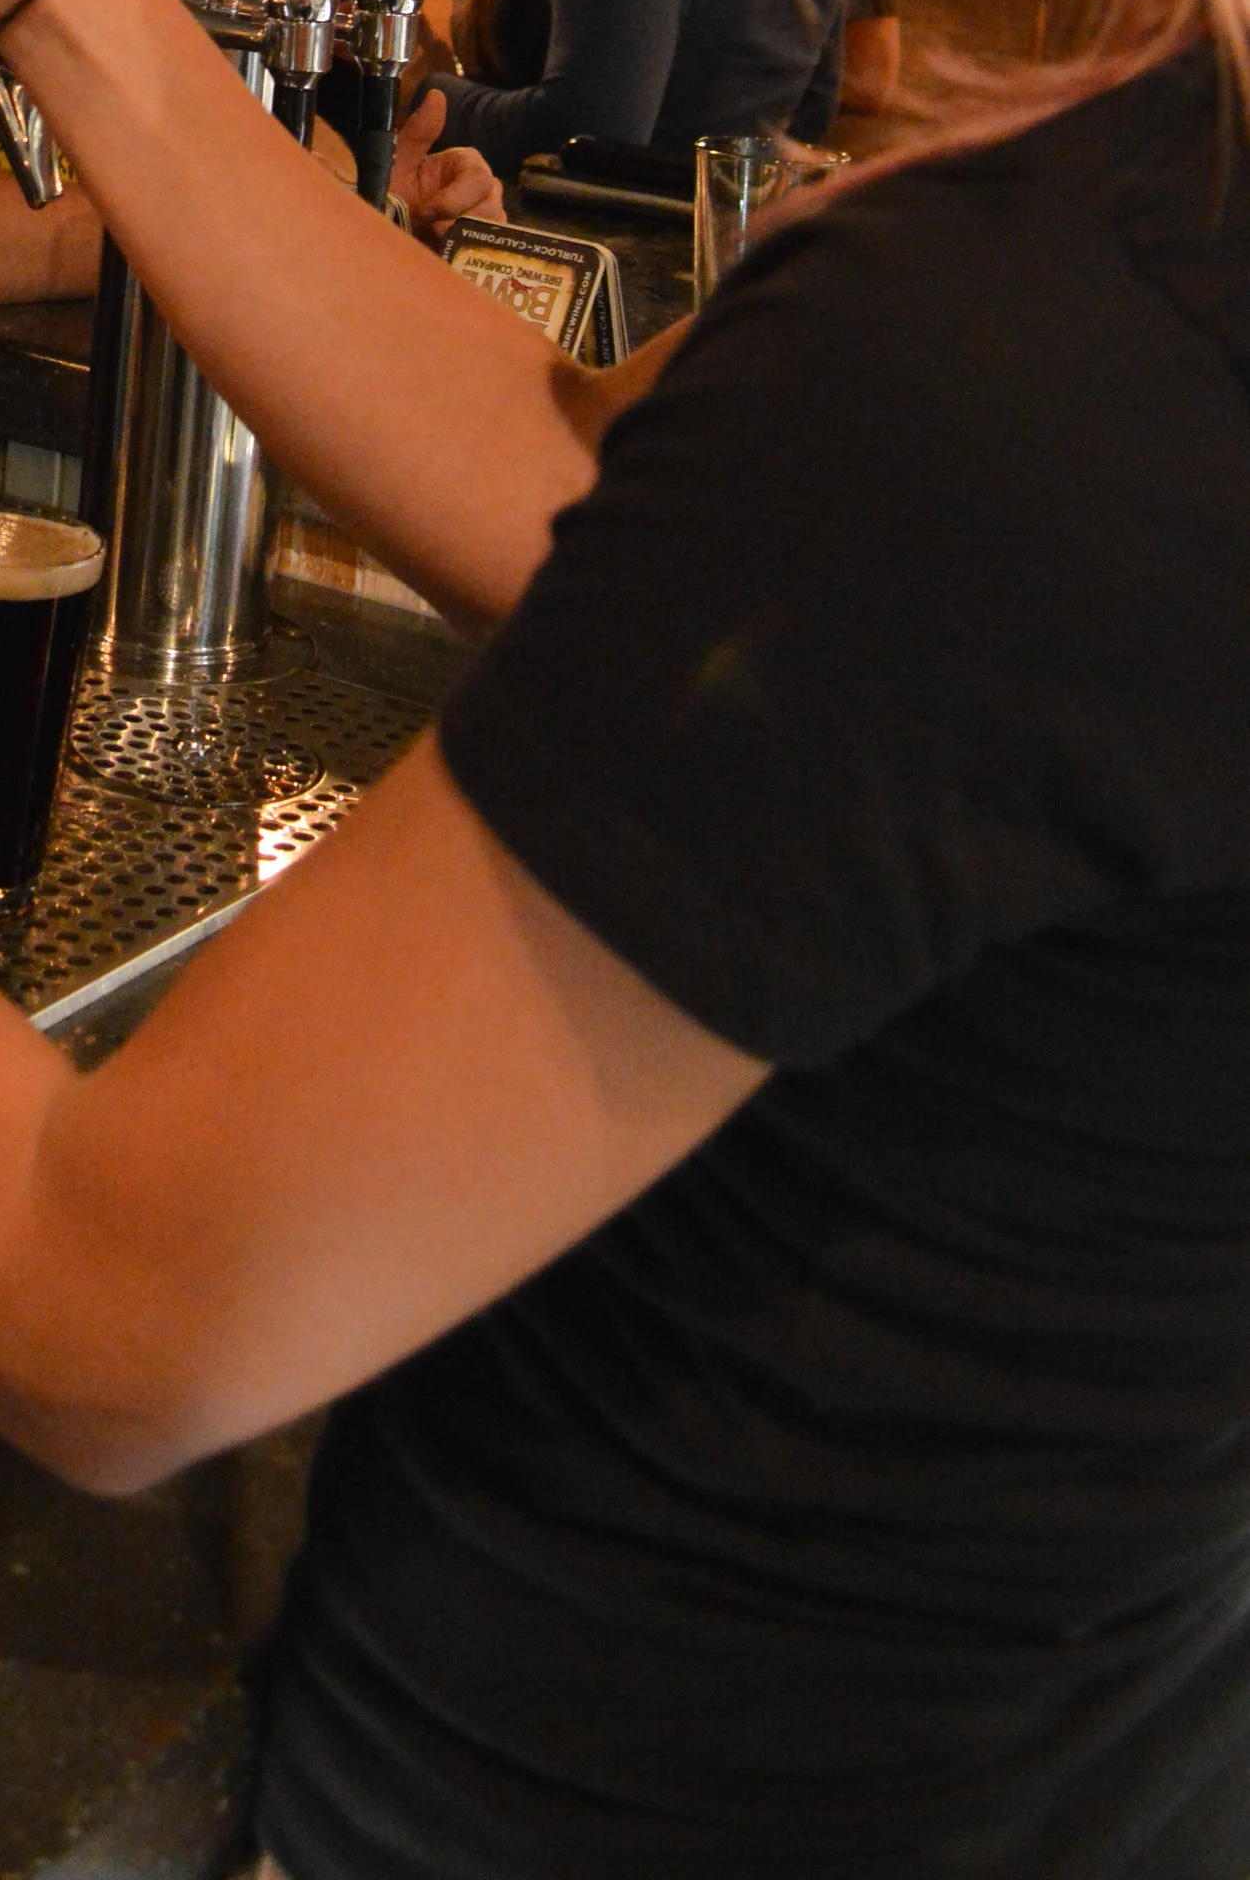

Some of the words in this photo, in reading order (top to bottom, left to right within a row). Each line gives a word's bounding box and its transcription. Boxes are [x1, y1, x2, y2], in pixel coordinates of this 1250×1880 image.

[463, 255, 514, 275] COMPANY
[516, 266, 563, 287] BREWING
[561, 270, 592, 351] BREWING.COM
